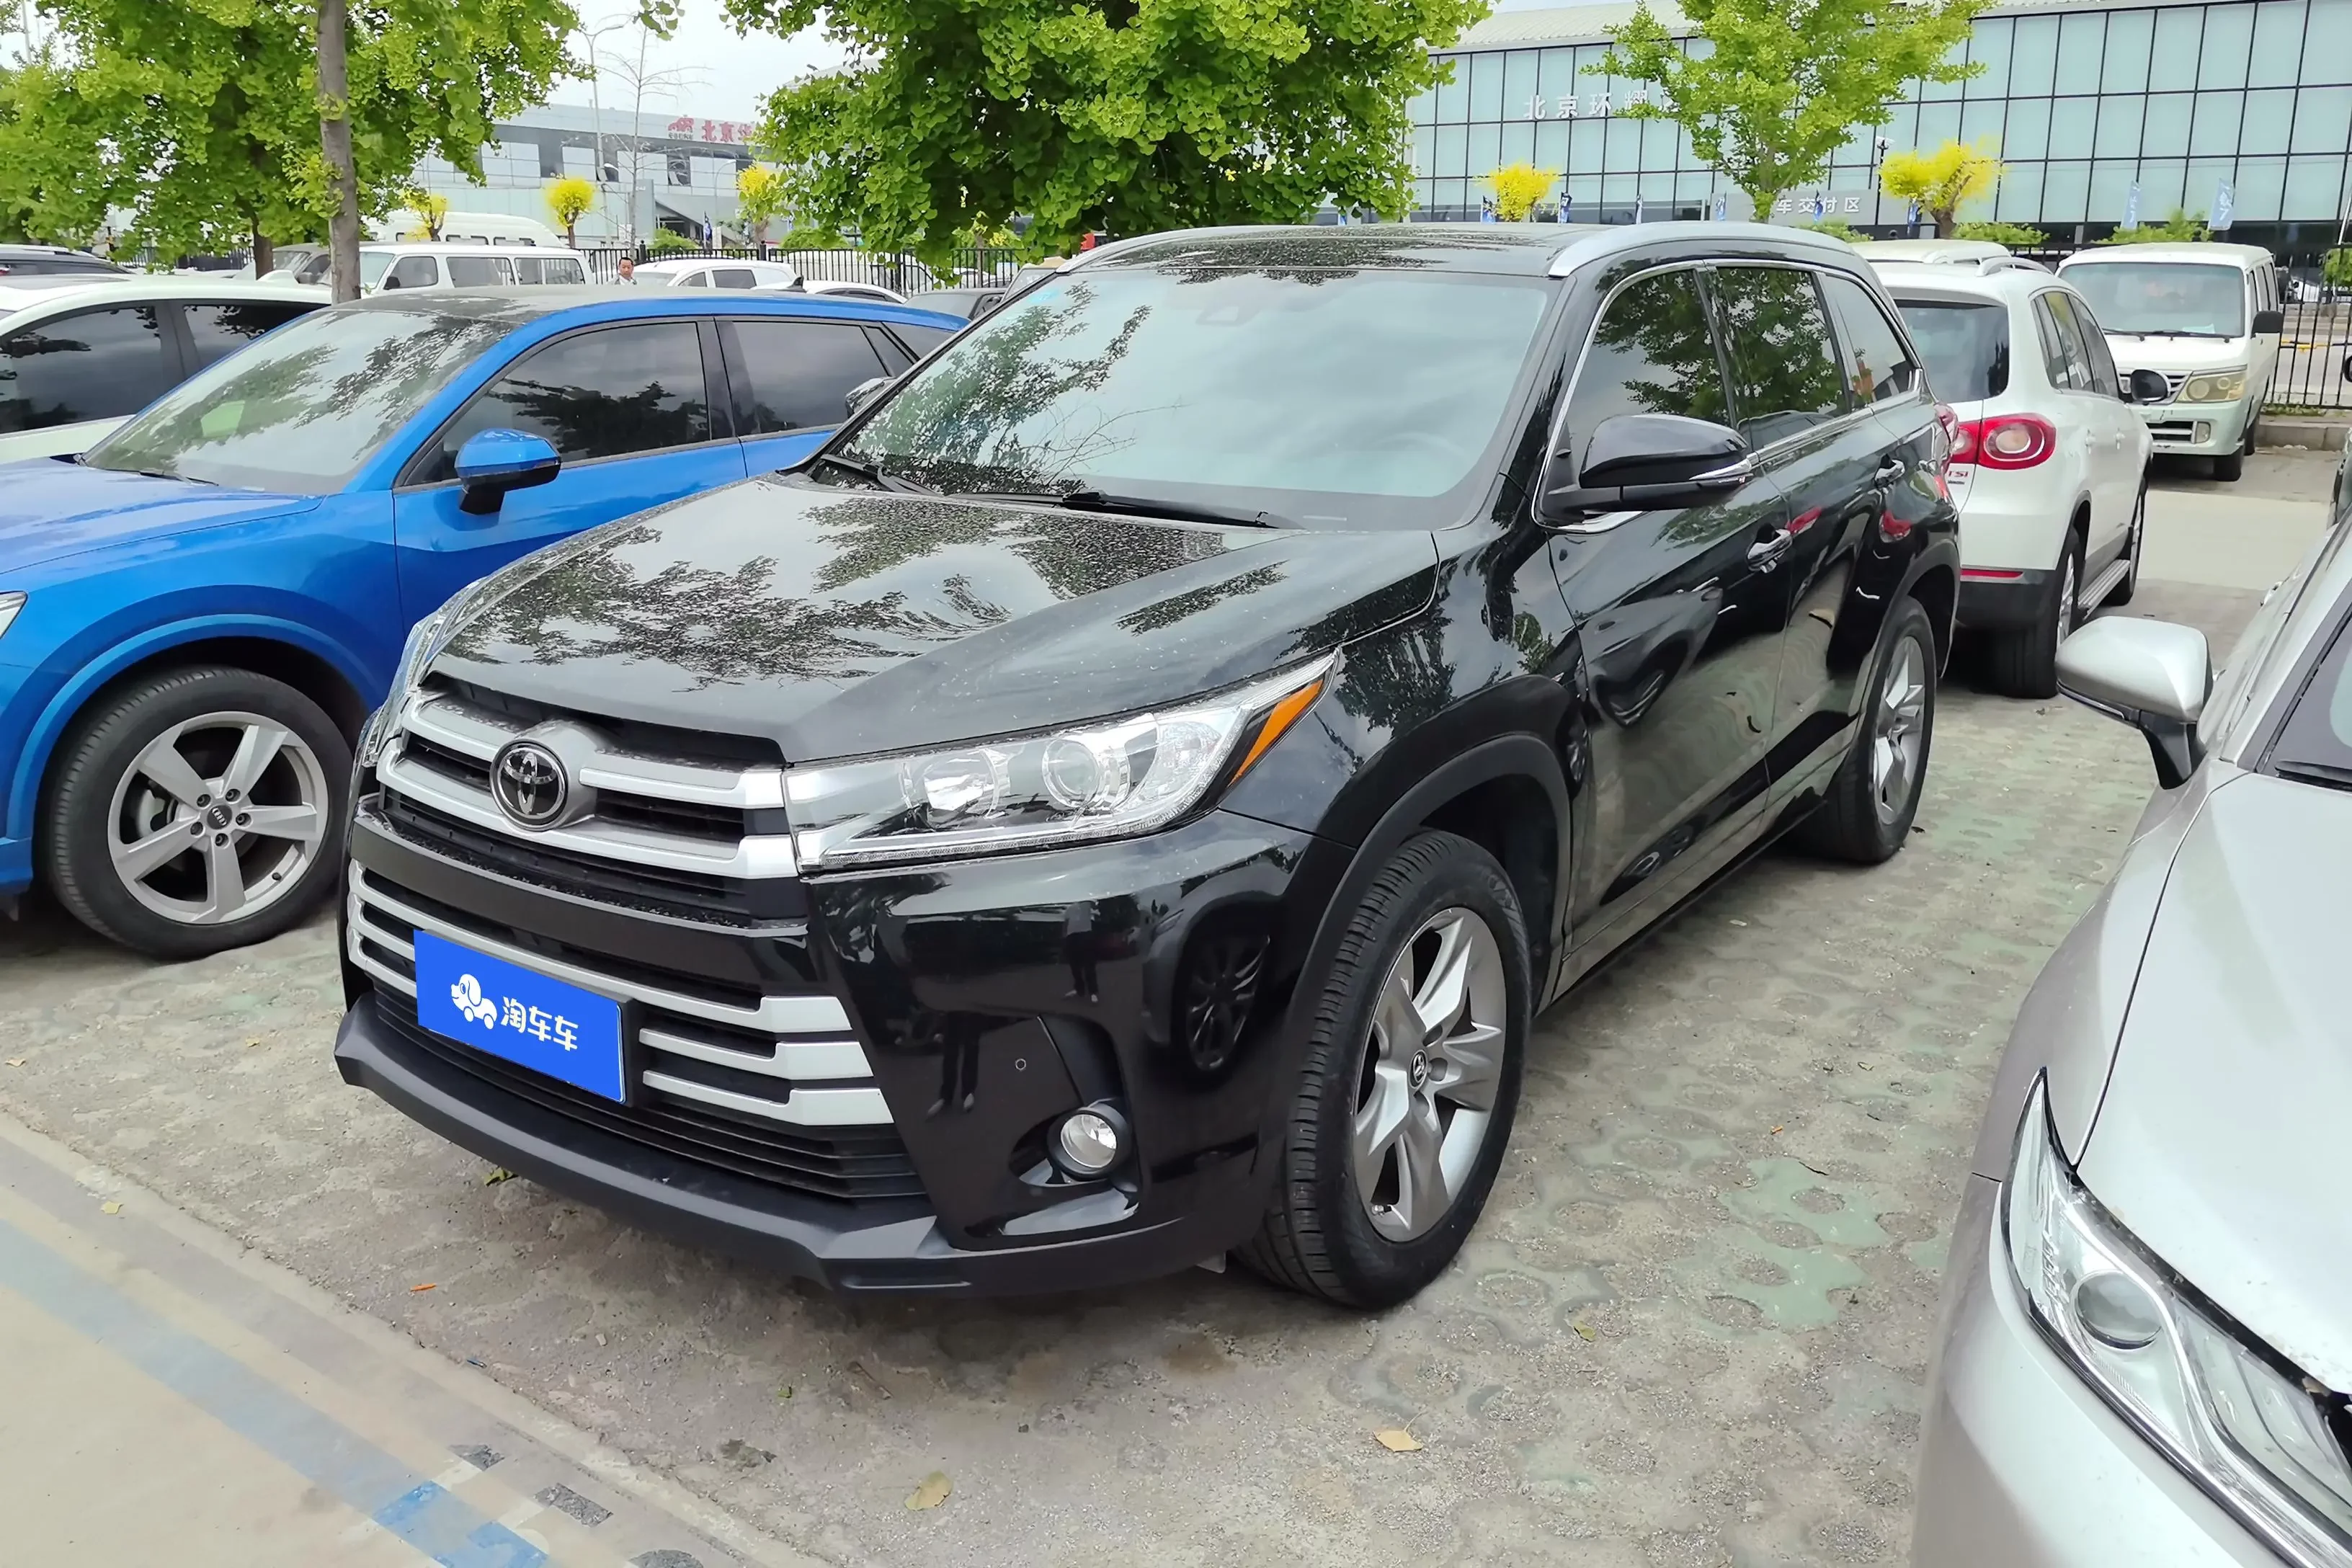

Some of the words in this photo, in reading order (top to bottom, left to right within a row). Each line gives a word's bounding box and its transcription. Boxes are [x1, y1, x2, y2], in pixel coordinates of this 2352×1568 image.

[1523, 90, 1679, 120] 北京环耀
[1776, 197, 1861, 214] 车交付区
